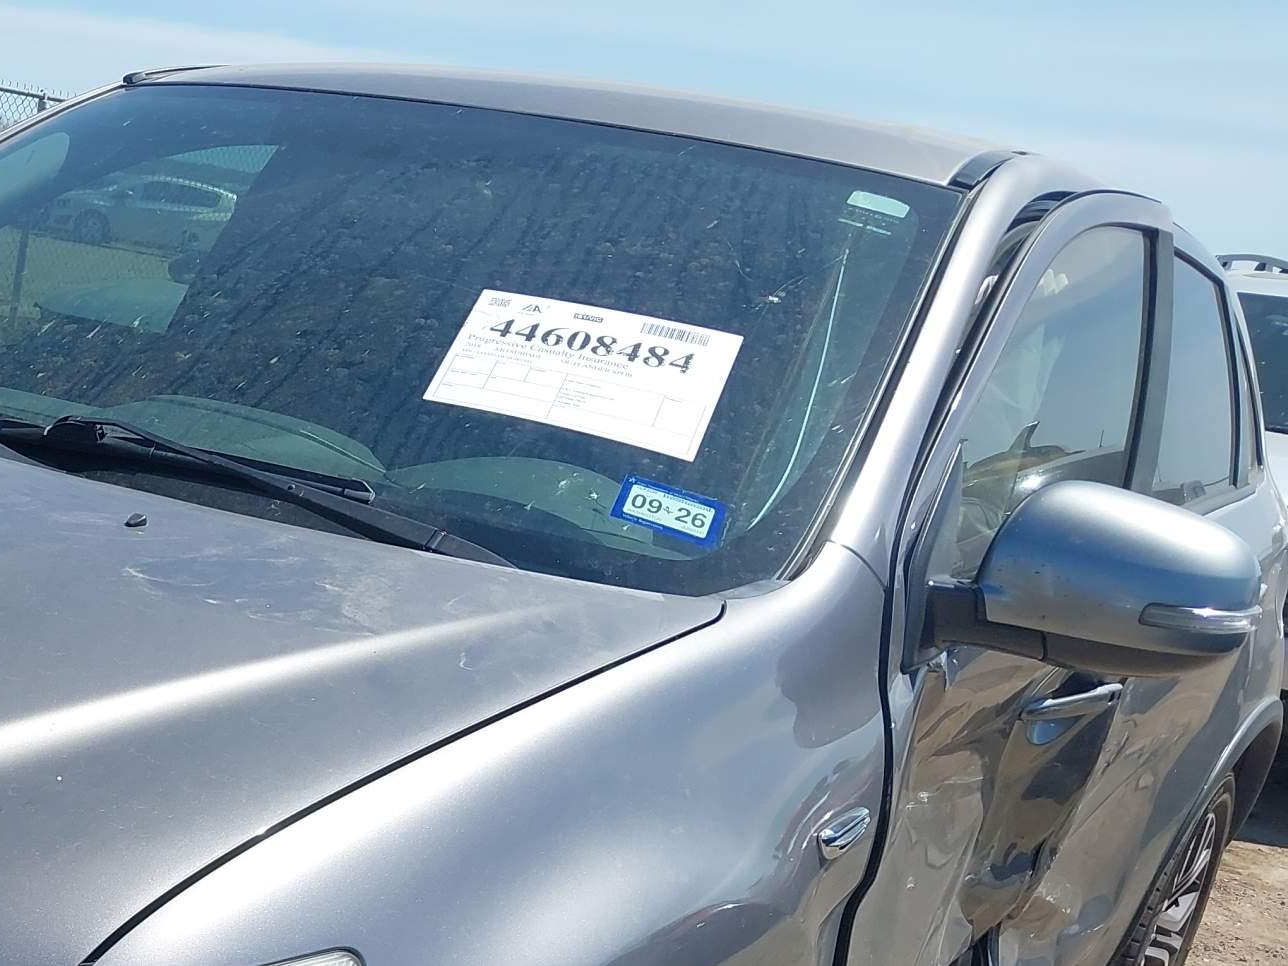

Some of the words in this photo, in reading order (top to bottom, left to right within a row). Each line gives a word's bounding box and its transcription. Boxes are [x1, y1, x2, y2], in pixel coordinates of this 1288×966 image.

[467, 333, 529, 350] Progressive
[530, 343, 576, 359] Casualty
[578, 352, 630, 369] Insurance
[488, 318, 697, 375] 44608484
[631, 493, 663, 514] 09
[674, 507, 708, 529] 26
